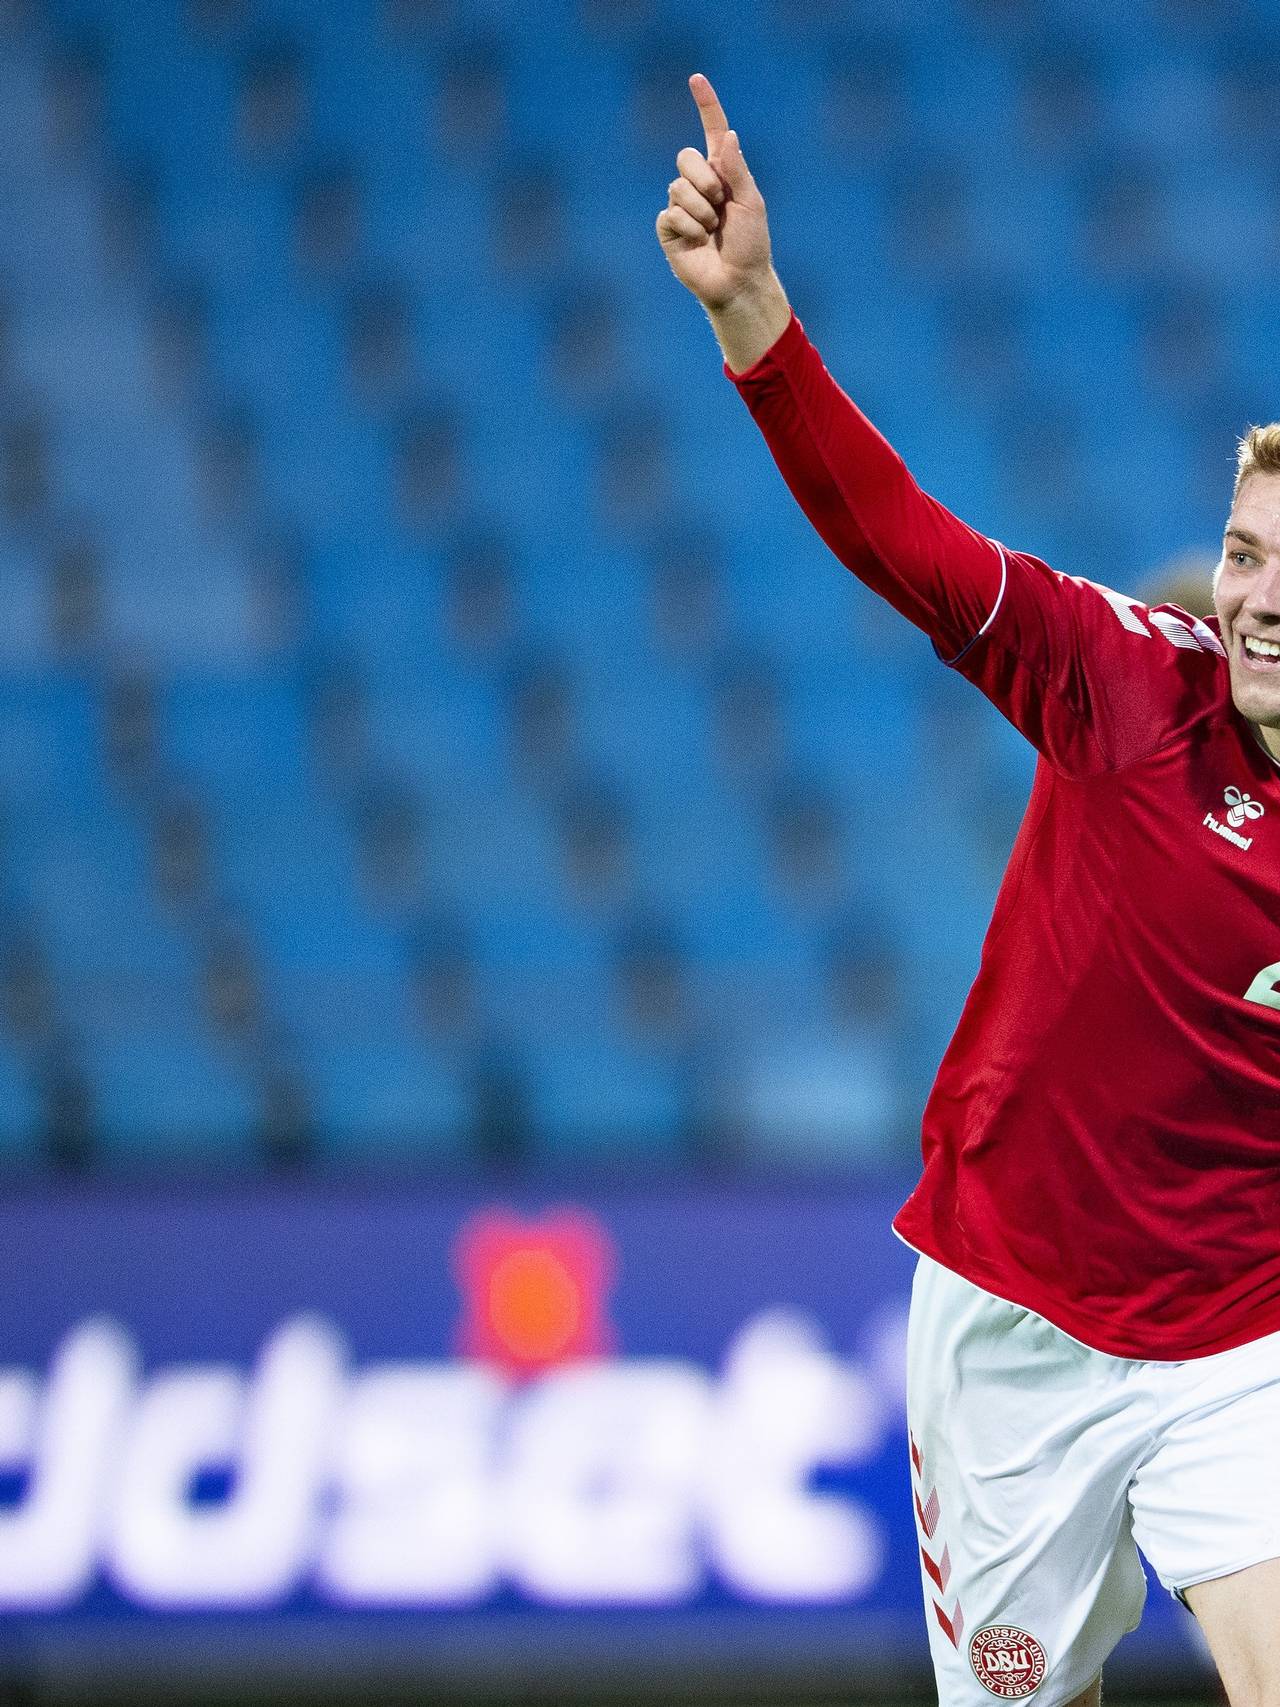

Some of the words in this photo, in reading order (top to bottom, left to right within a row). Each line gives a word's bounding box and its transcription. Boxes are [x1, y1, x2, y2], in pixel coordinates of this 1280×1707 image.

[1203, 812, 1253, 851] hummel
[972, 1646, 996, 1689] DANSK
[999, 1684, 1031, 1695] 1889
[983, 1649, 1031, 1672] DBU
